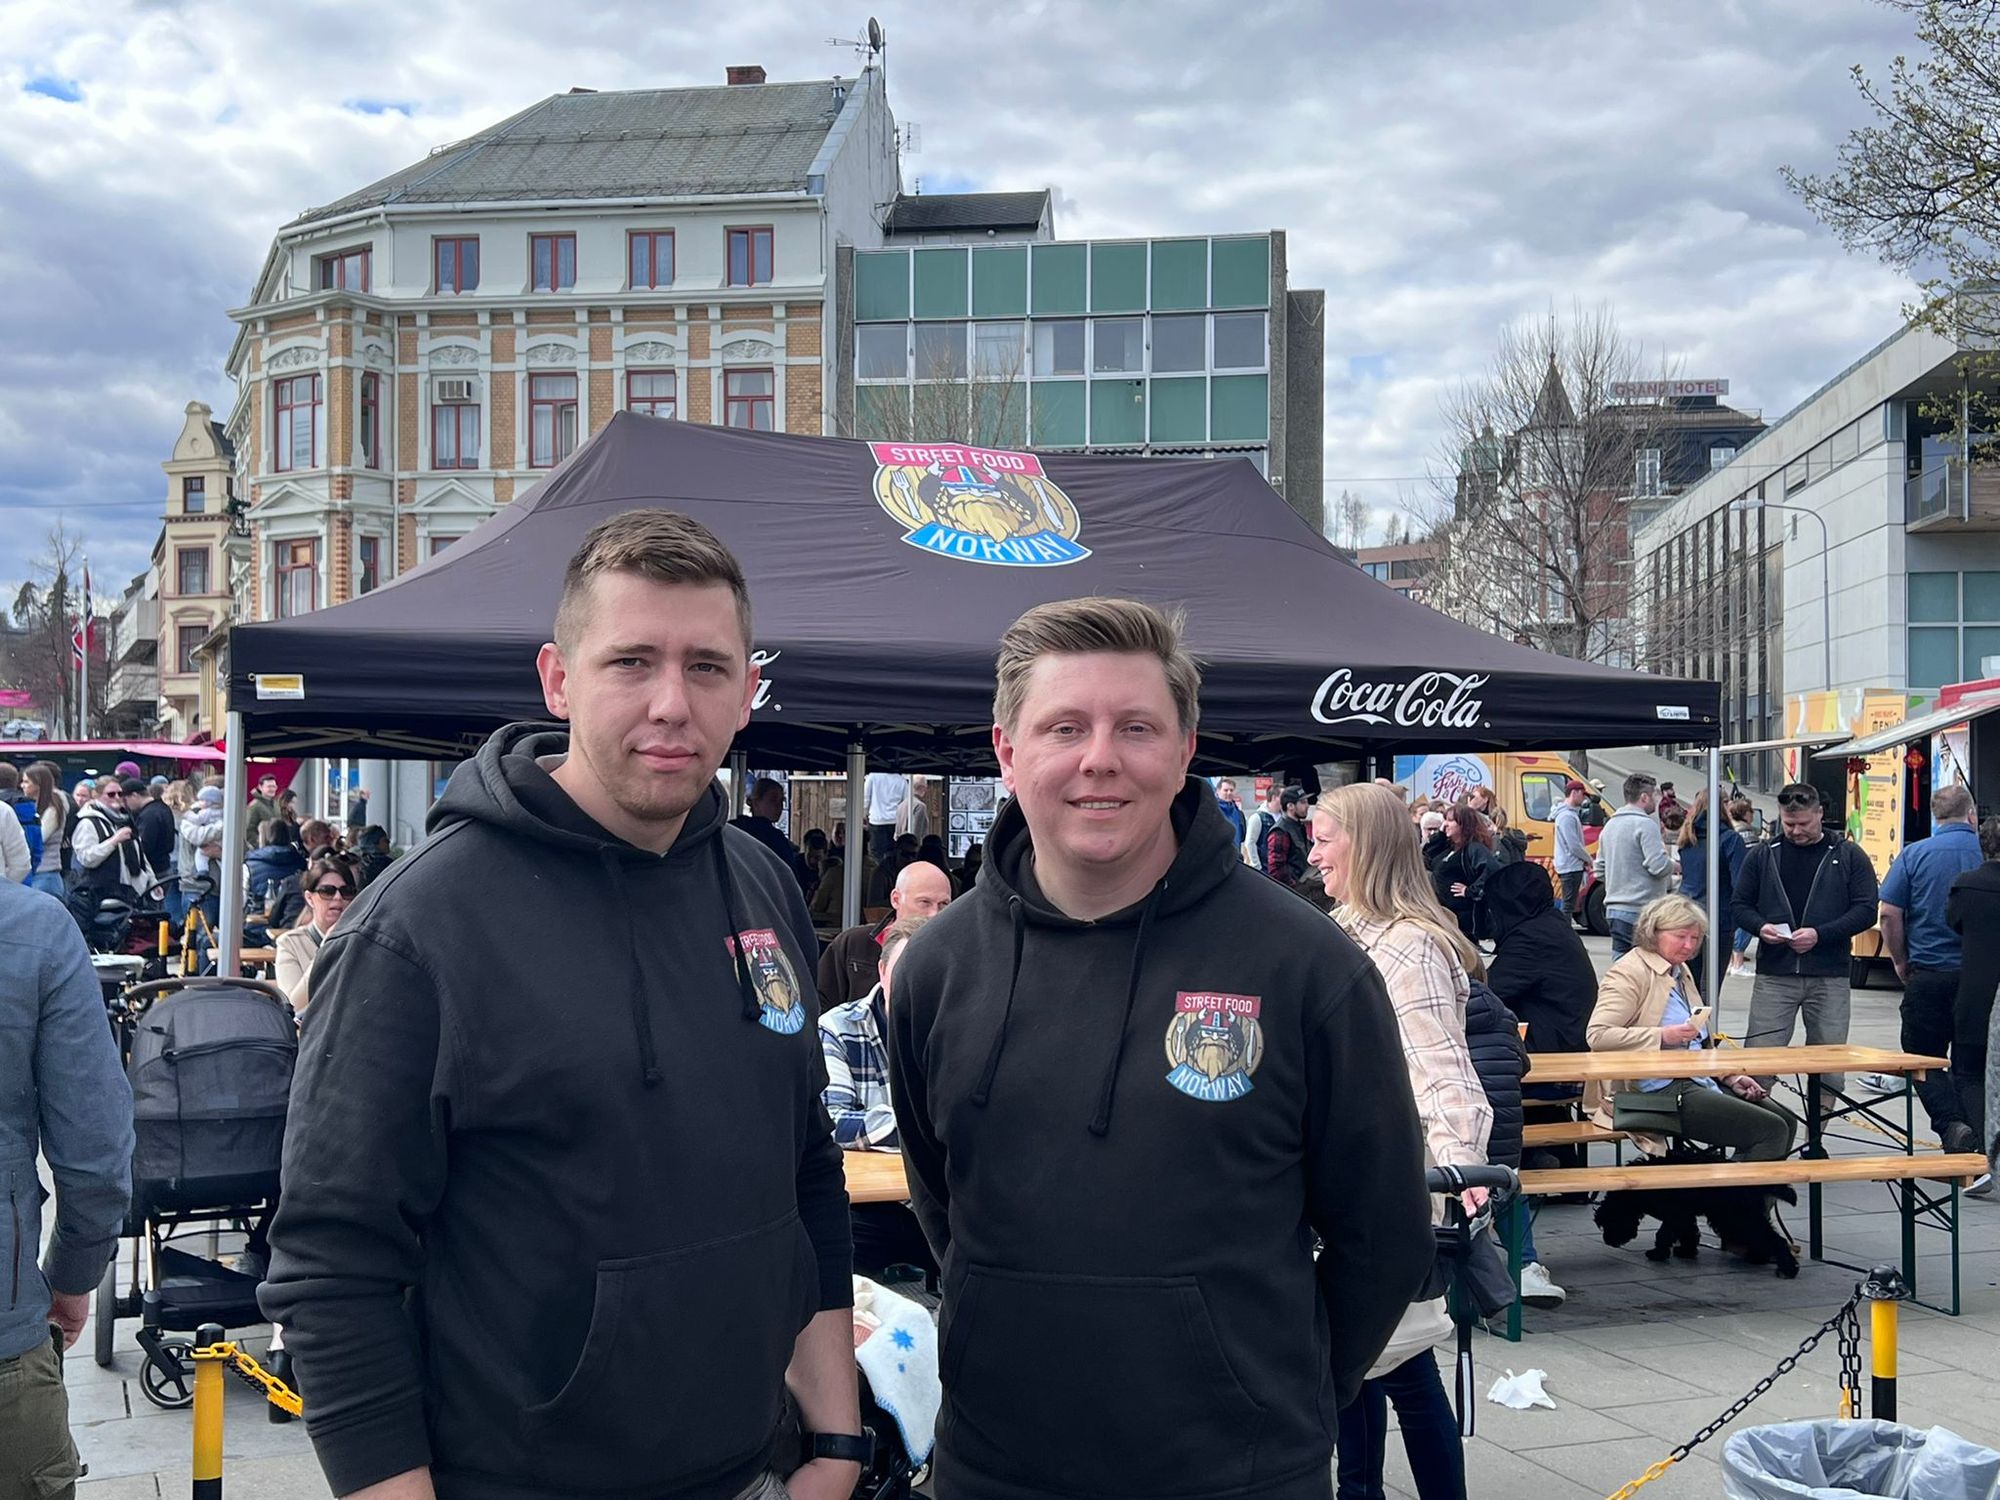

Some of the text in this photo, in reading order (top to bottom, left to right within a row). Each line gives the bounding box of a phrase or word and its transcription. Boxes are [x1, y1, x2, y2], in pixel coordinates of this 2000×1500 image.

[1615, 382, 1724, 396] GRAND HOTEL
[891, 447, 1026, 471] STREET FOOD
[926, 528, 1073, 562] NORWAY
[1432, 771, 1463, 799] Fish
[1184, 996, 1253, 1013] STREET FOOD
[1174, 1068, 1245, 1099] NORWAY
